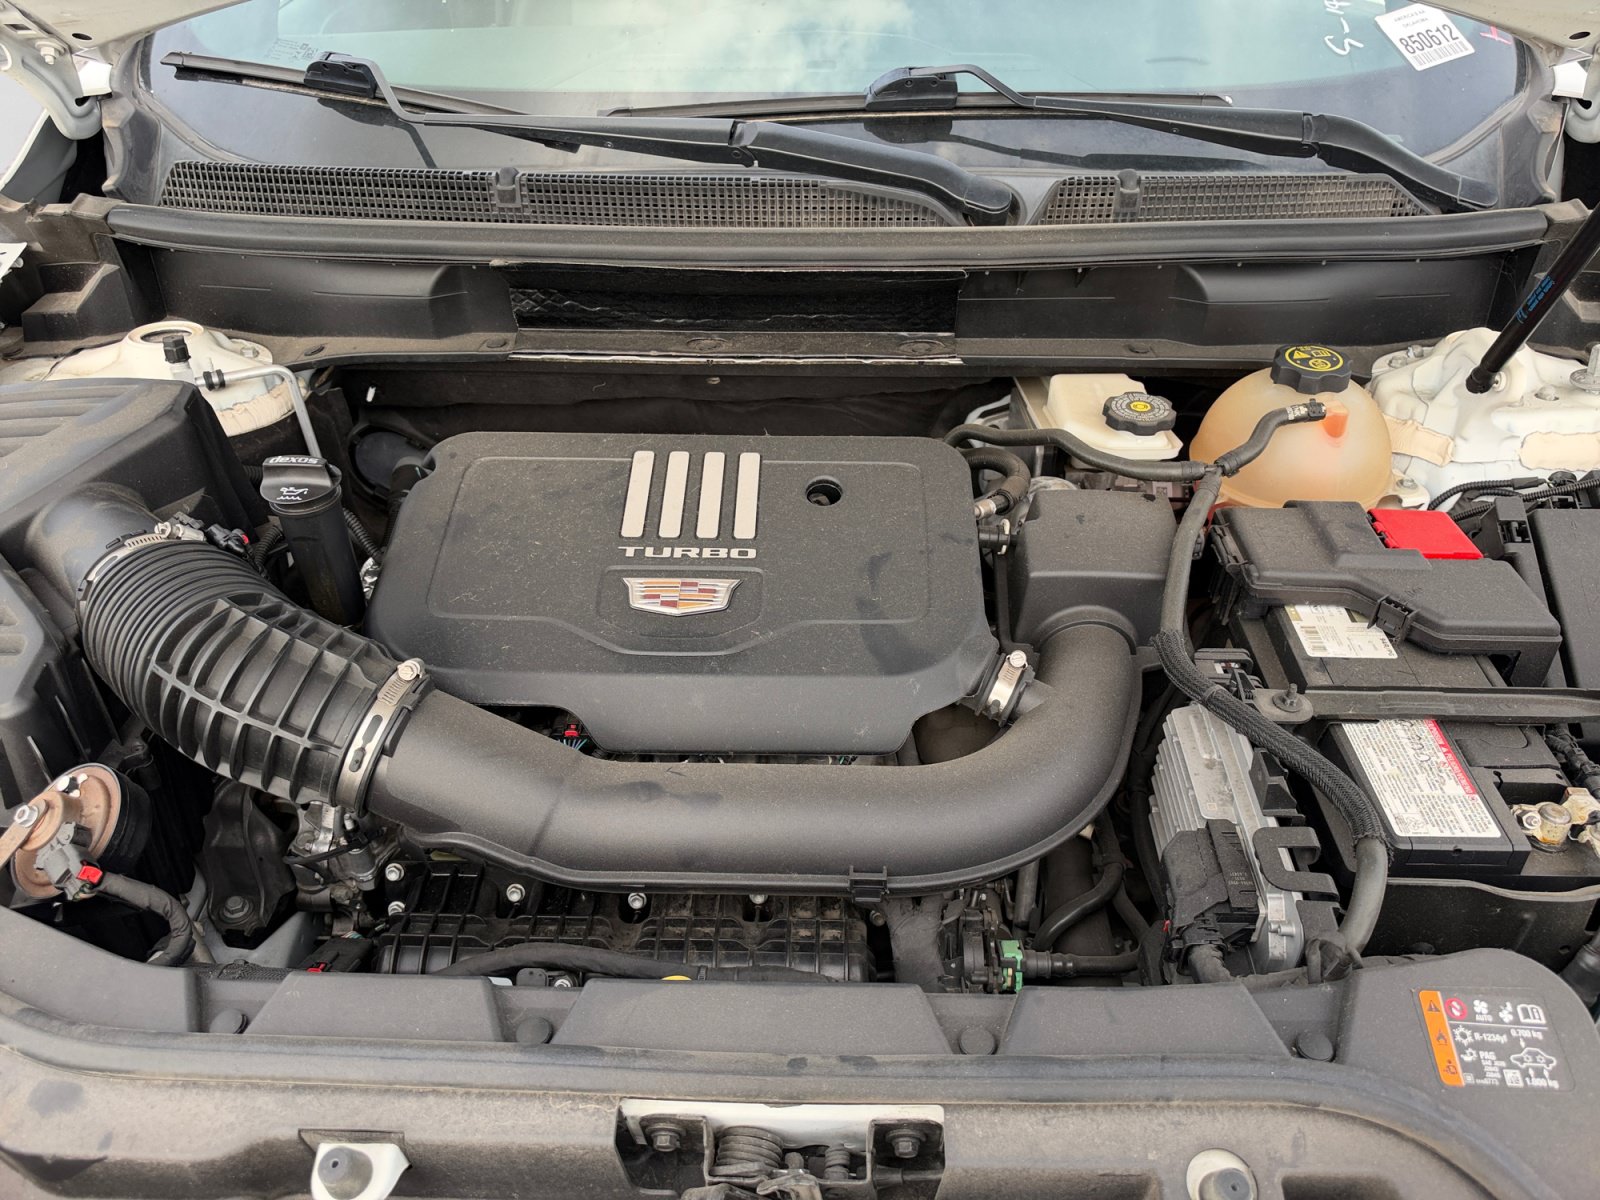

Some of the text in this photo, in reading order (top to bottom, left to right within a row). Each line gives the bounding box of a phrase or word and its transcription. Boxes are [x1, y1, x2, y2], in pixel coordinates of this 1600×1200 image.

[1399, 24, 1460, 54] 850612
[269, 455, 319, 464] dexos
[618, 546, 757, 559] TURBO
[1475, 1014, 1493, 1022] AUTO
